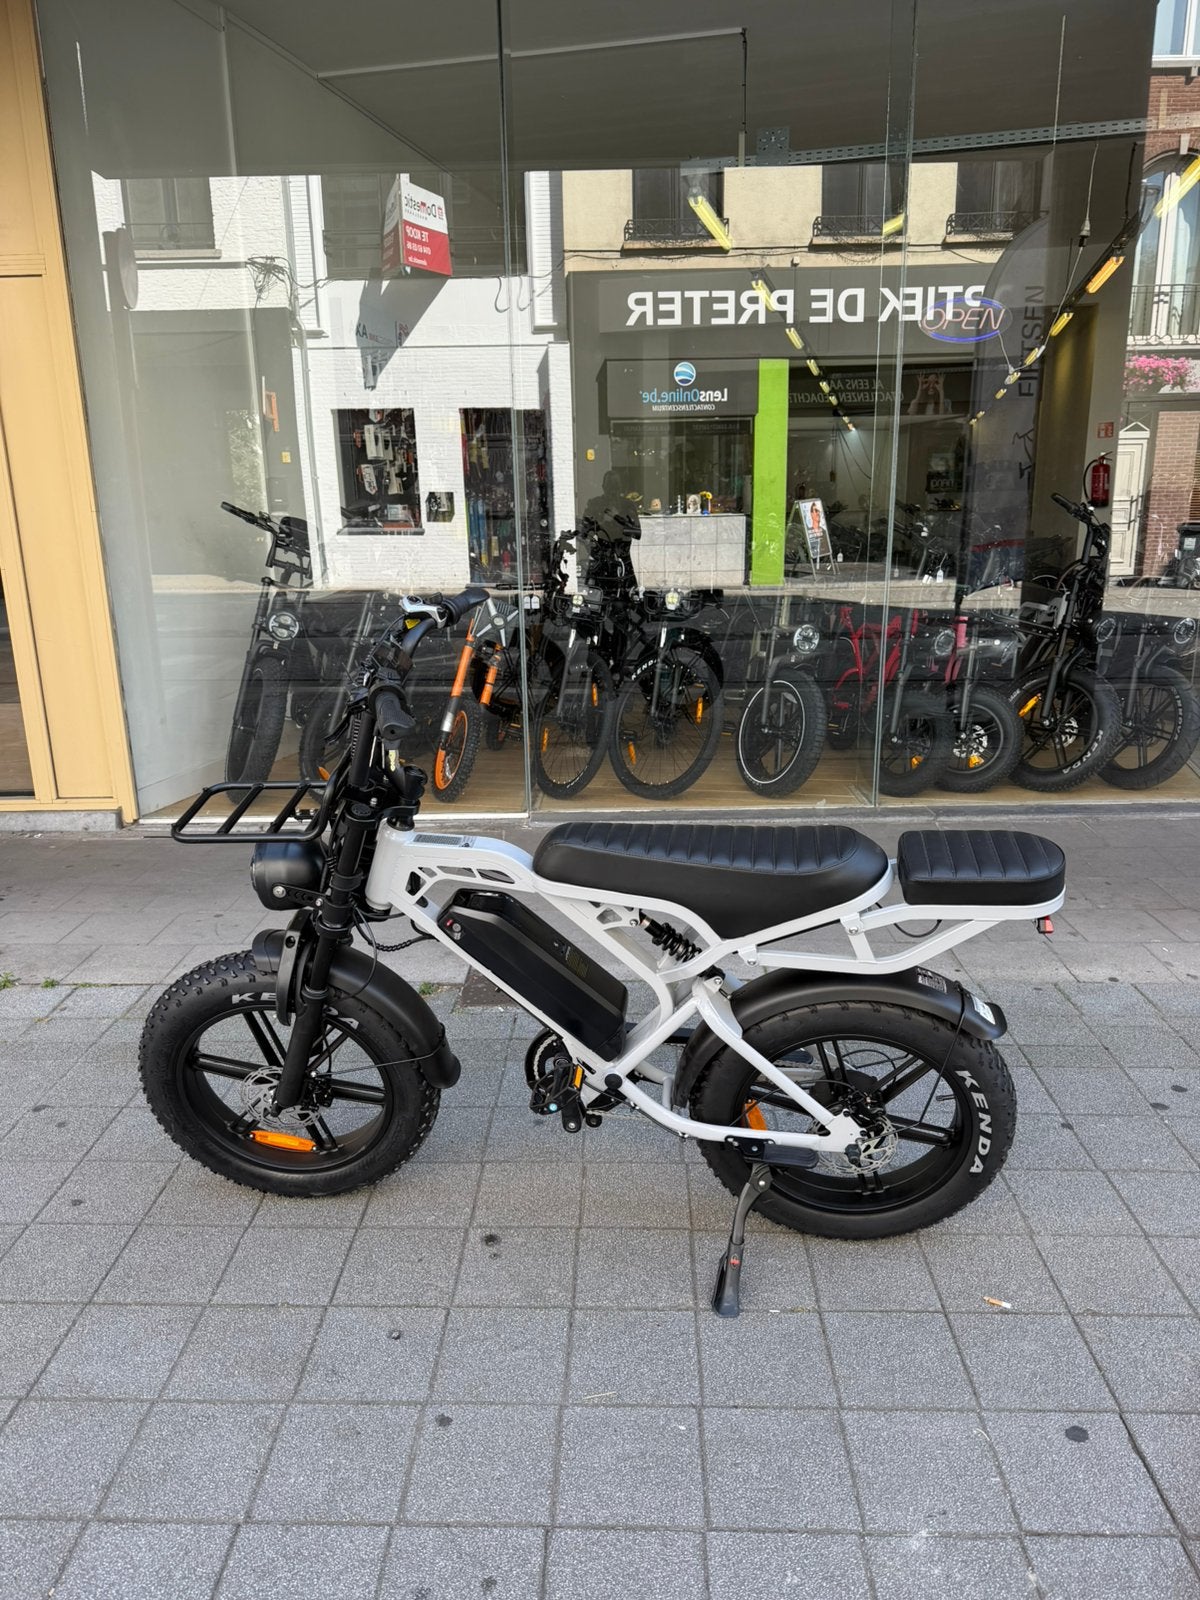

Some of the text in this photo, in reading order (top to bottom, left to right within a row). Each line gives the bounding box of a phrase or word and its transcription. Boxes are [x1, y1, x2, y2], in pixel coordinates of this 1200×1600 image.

[920, 306, 1006, 331] OPEN
[1062, 729, 1104, 774] KENDA
[231, 992, 360, 1031] KEDA
[954, 1070, 993, 1174] KENDA
